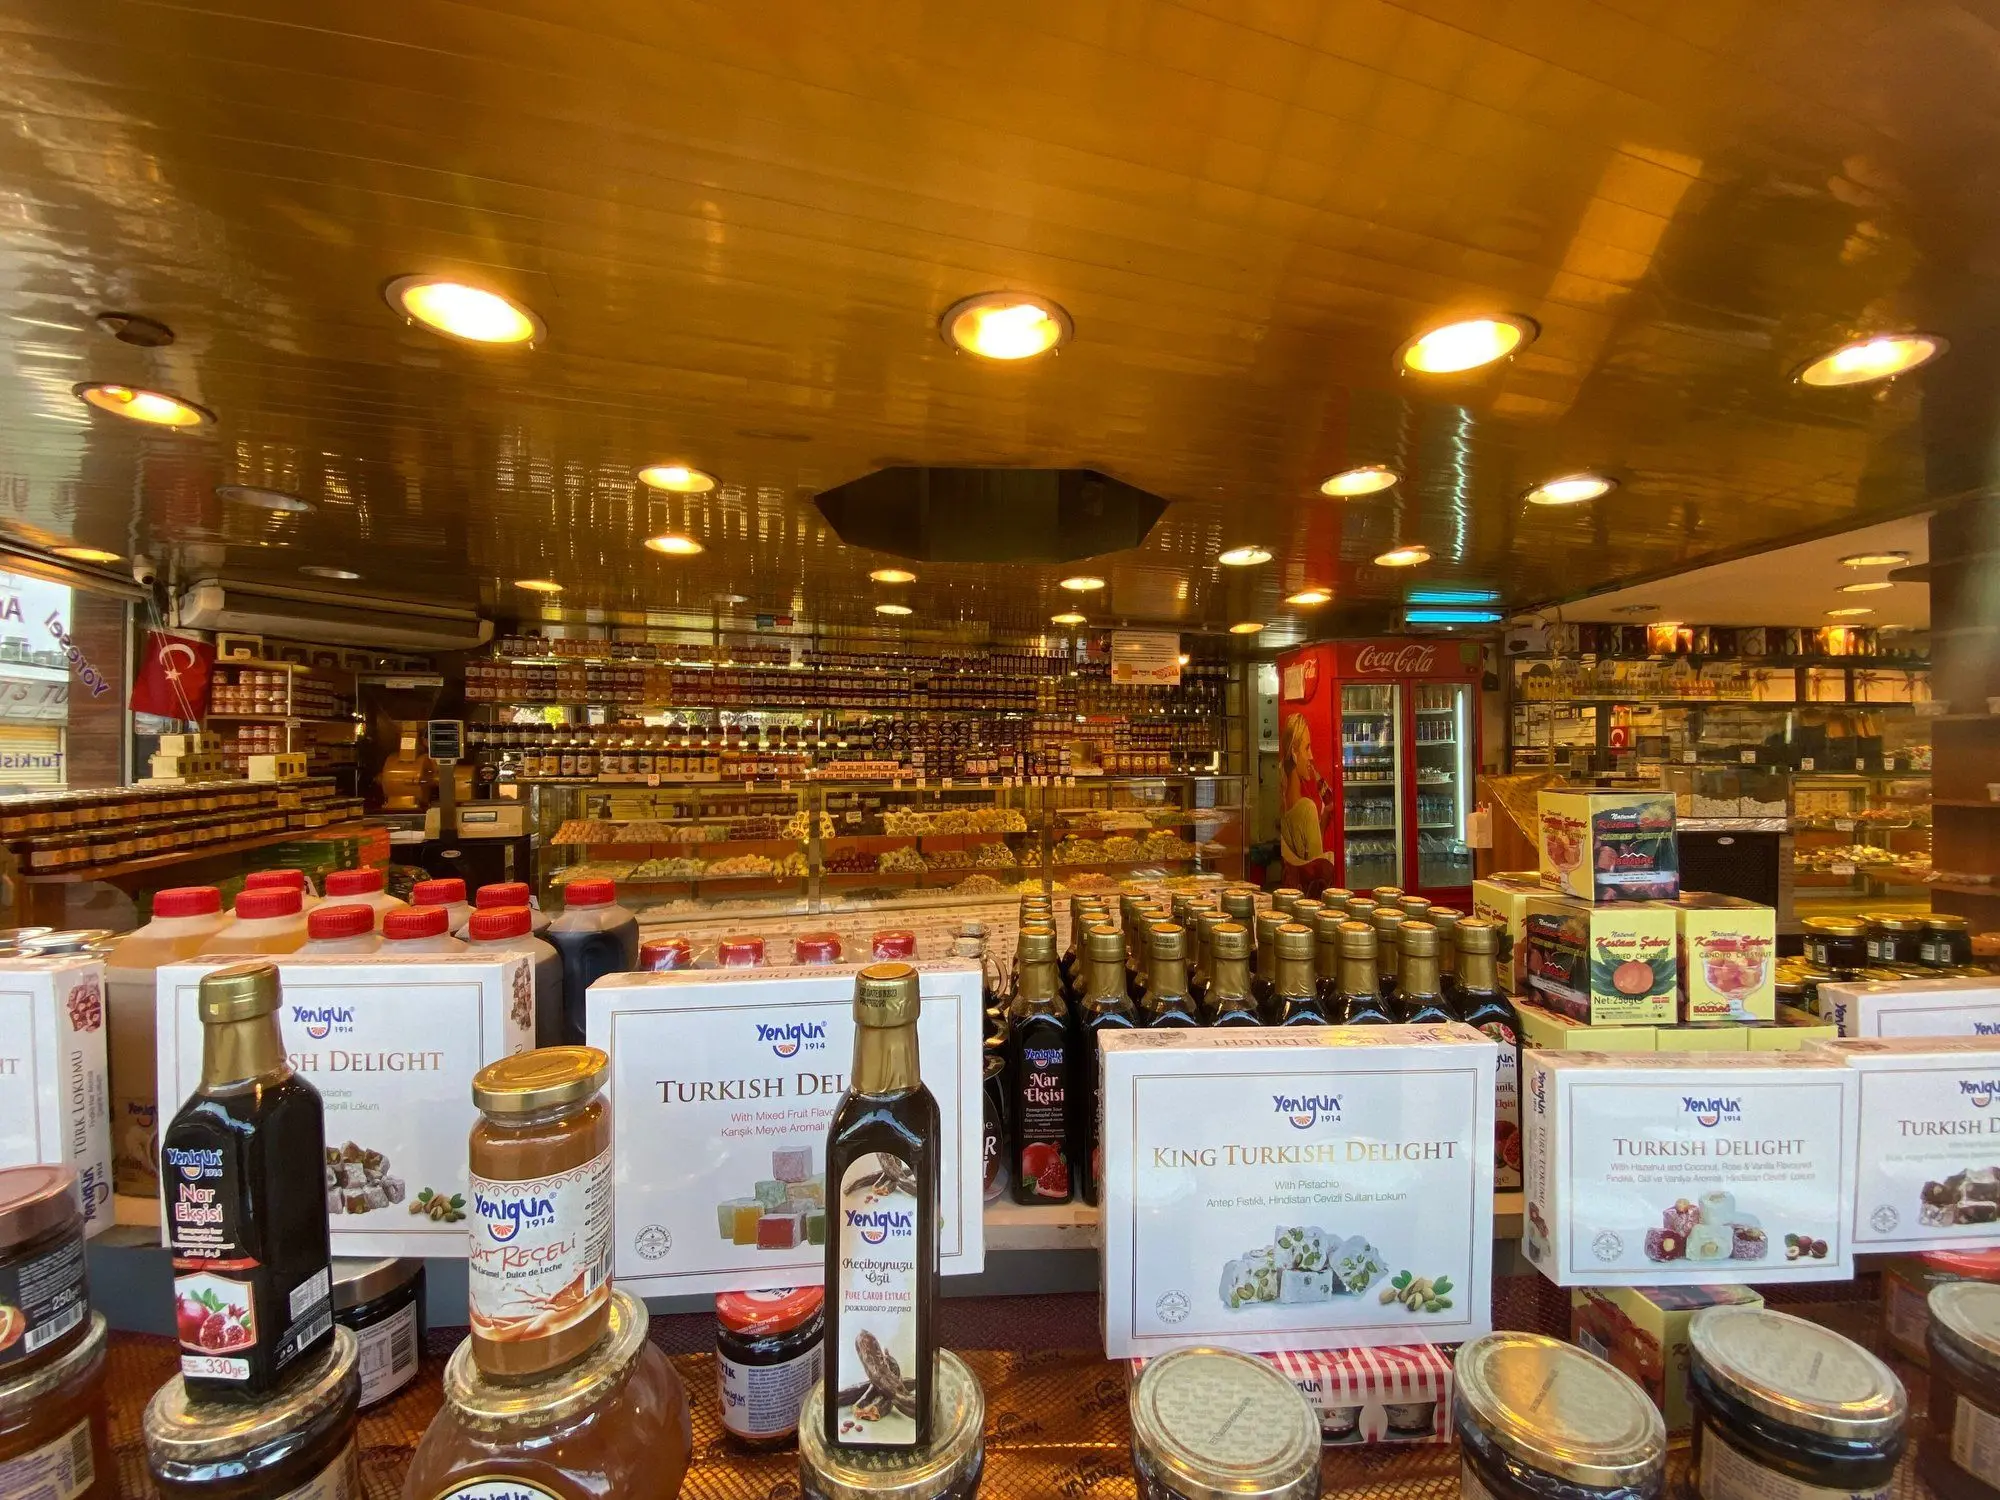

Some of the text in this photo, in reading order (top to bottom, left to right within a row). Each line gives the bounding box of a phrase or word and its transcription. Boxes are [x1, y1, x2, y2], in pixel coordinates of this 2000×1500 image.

[805, 1042, 826, 1050] 1914
[329, 1050, 444, 1072] DELIGHT
[1029, 1072, 1059, 1088] Nar
[656, 1077, 784, 1104] TURKISH
[731, 1112, 753, 1123] With
[755, 1110, 785, 1122] Mixed
[787, 1108, 808, 1119] Fruit
[1320, 1114, 1341, 1122] 1914
[755, 1125, 787, 1137] Meyve
[1898, 1119, 1982, 1137] TURKISH
[1152, 1141, 1458, 1168] KING TURKISH DELIGHT
[1612, 1138, 1805, 1157] TURKISH DELIGHT
[1610, 1163, 1630, 1172] With
[1667, 1162, 1683, 1171] and
[1743, 1162, 1750, 1171] &
[1274, 1179, 1340, 1190] With Pistachio
[180, 1183, 215, 1203] Nar
[1206, 1198, 1234, 1209] Antep
[1268, 1195, 1311, 1206] Hindistan
[1344, 1193, 1374, 1203] Sultan
[1375, 1191, 1407, 1202] Lokum
[175, 1202, 223, 1226] Ekşisi
[525, 1215, 555, 1229] 1914
[891, 1229, 912, 1237] 1914
[506, 1270, 527, 1280] Dulce
[528, 1267, 539, 1277] de
[540, 1262, 563, 1275] Leche
[842, 1257, 914, 1273] Keçiboynuzu
[865, 1270, 890, 1286] Özü
[845, 1290, 911, 1301] PURE CAROB EXTRACT
